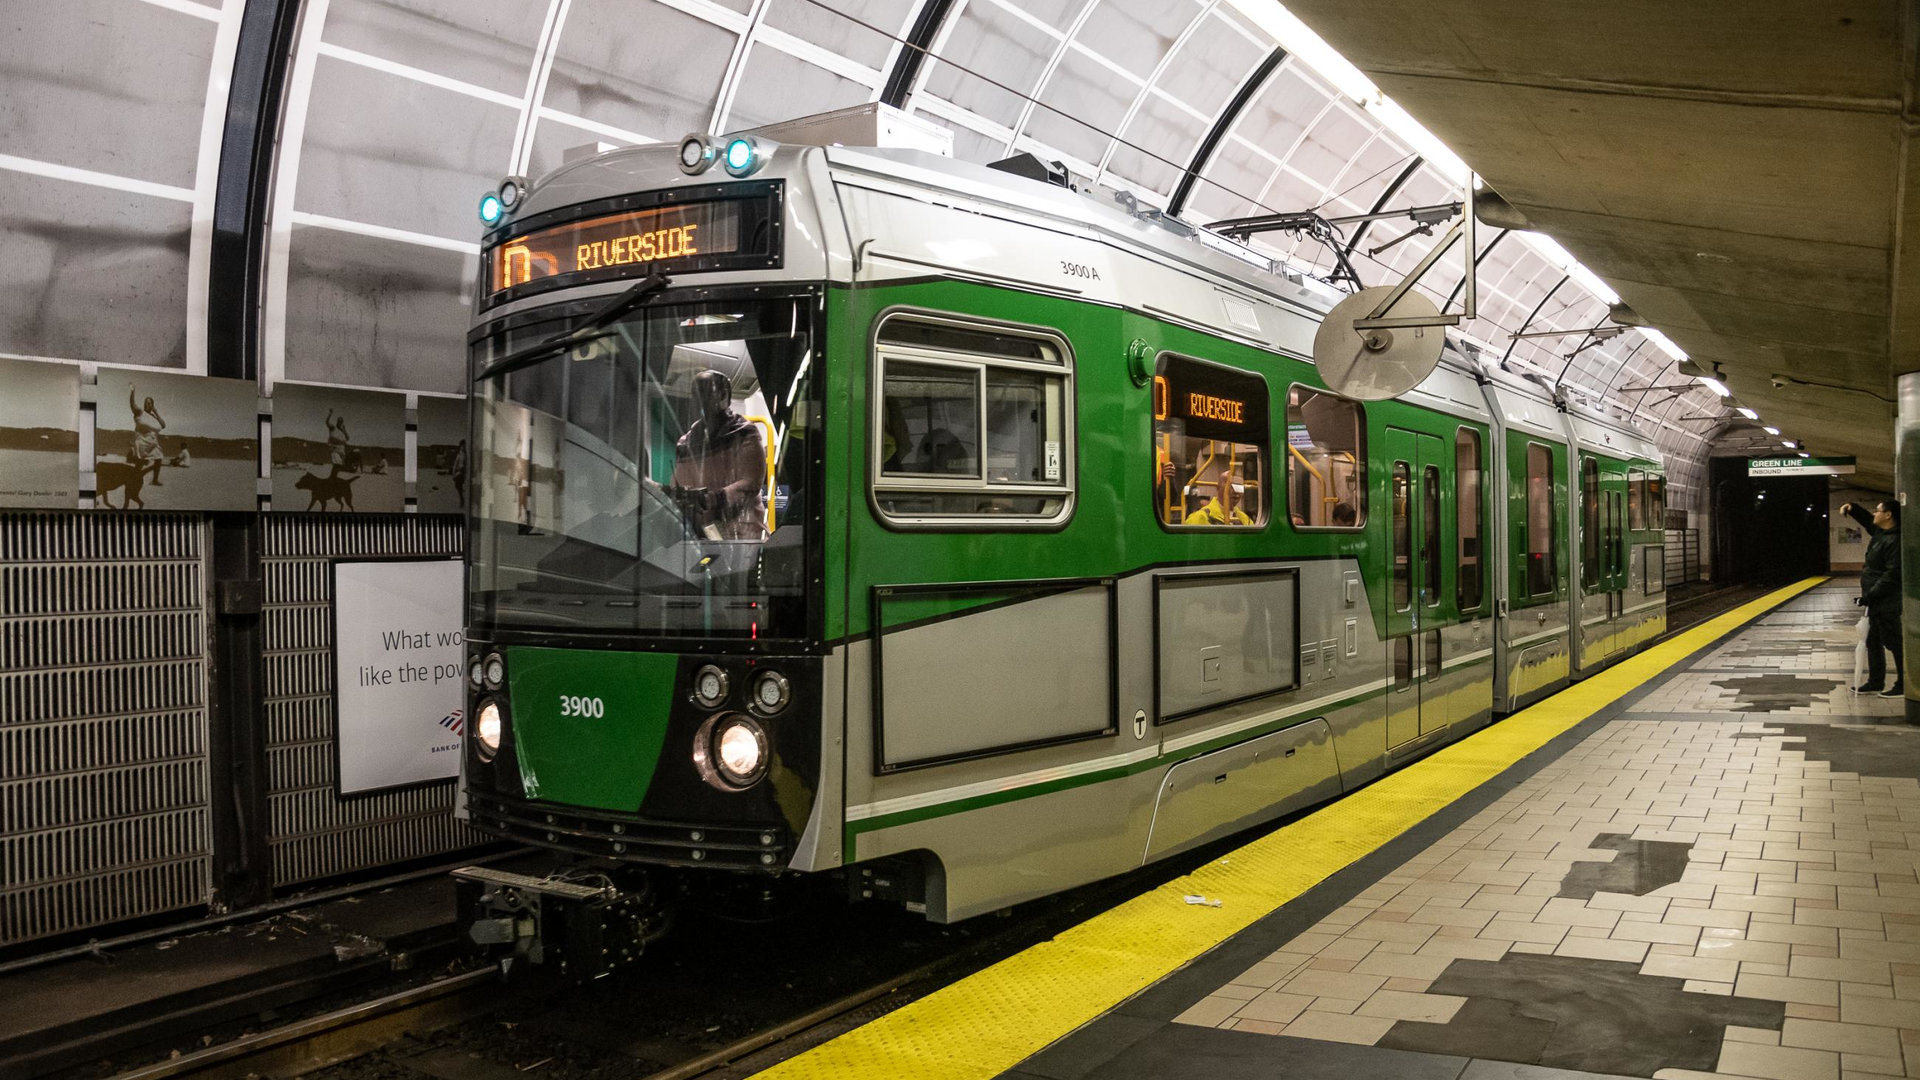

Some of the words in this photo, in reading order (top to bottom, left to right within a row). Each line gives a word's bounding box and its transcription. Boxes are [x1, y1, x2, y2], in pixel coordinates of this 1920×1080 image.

[577, 224, 697, 271] RIVERSIDE
[1061, 261, 1090, 279] 3900
[1092, 267, 1101, 281] A
[1191, 393, 1243, 423] RIVERSIDE
[1752, 460, 1780, 468] GREEN
[382, 629, 431, 651] What
[360, 665, 392, 687] like
[398, 662, 428, 683] the
[560, 694, 604, 719] 3900
[431, 744, 451, 753] BANK
[451, 743, 460, 751] OF
